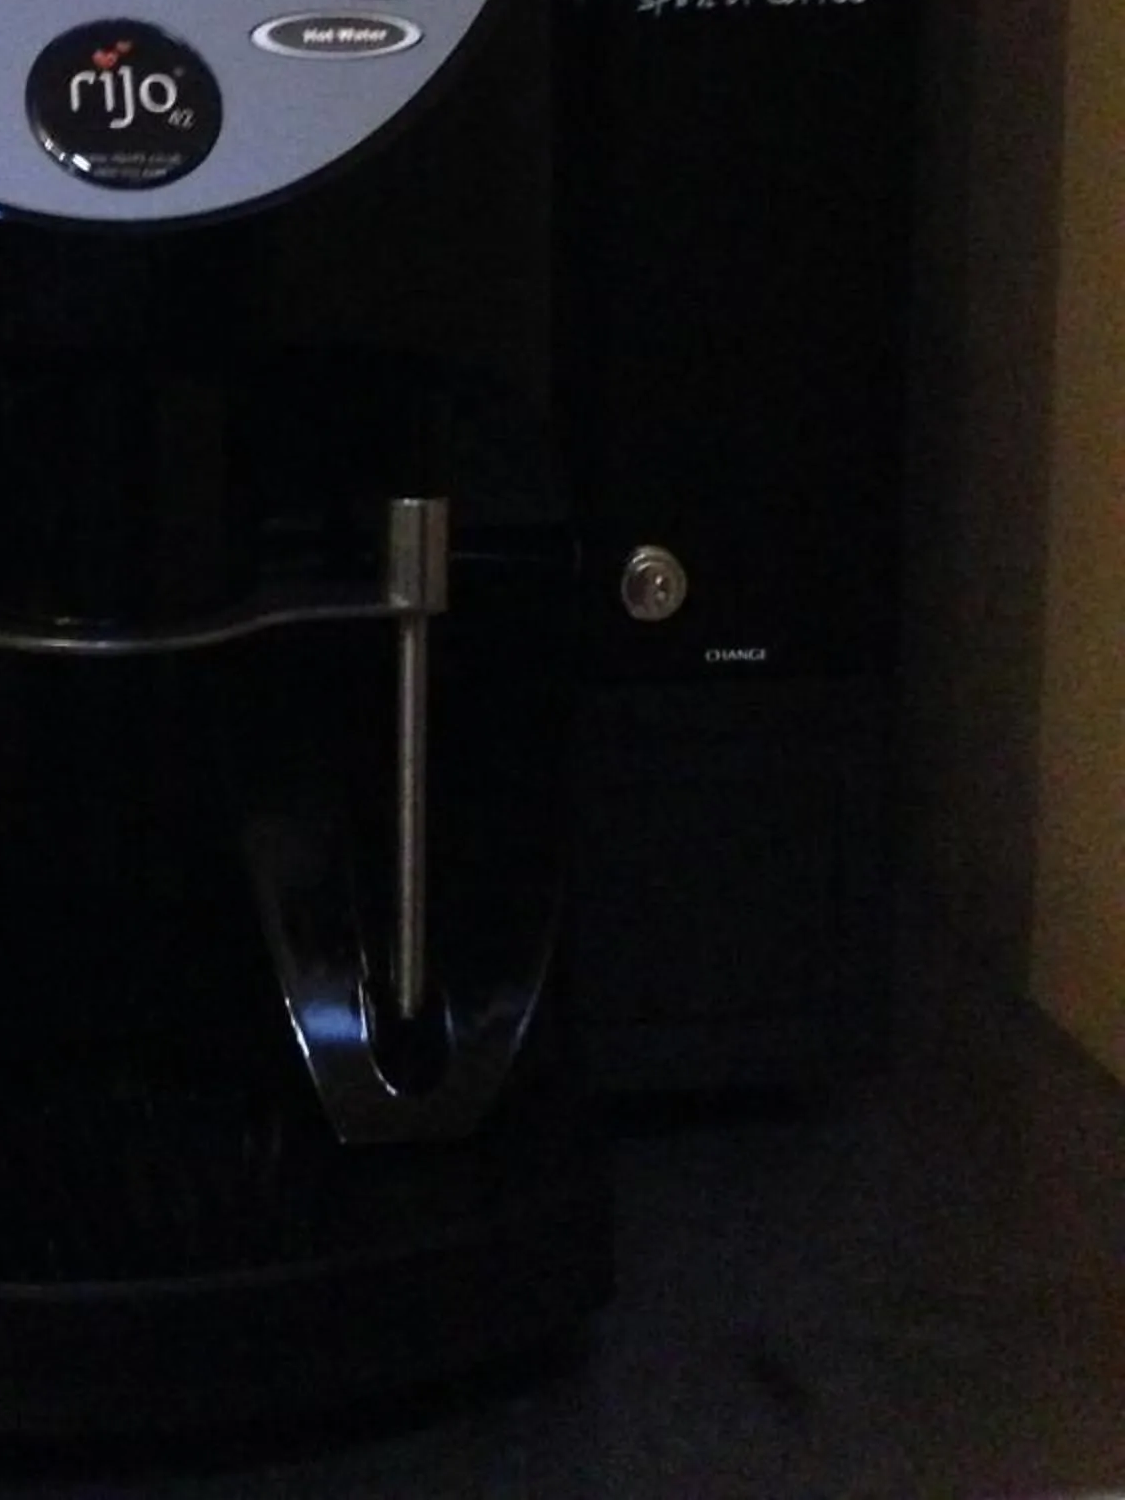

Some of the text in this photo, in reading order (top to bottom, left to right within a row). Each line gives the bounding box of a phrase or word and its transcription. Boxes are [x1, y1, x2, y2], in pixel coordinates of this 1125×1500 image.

[302, 26, 388, 43] Hot Water
[70, 65, 177, 129] rijo
